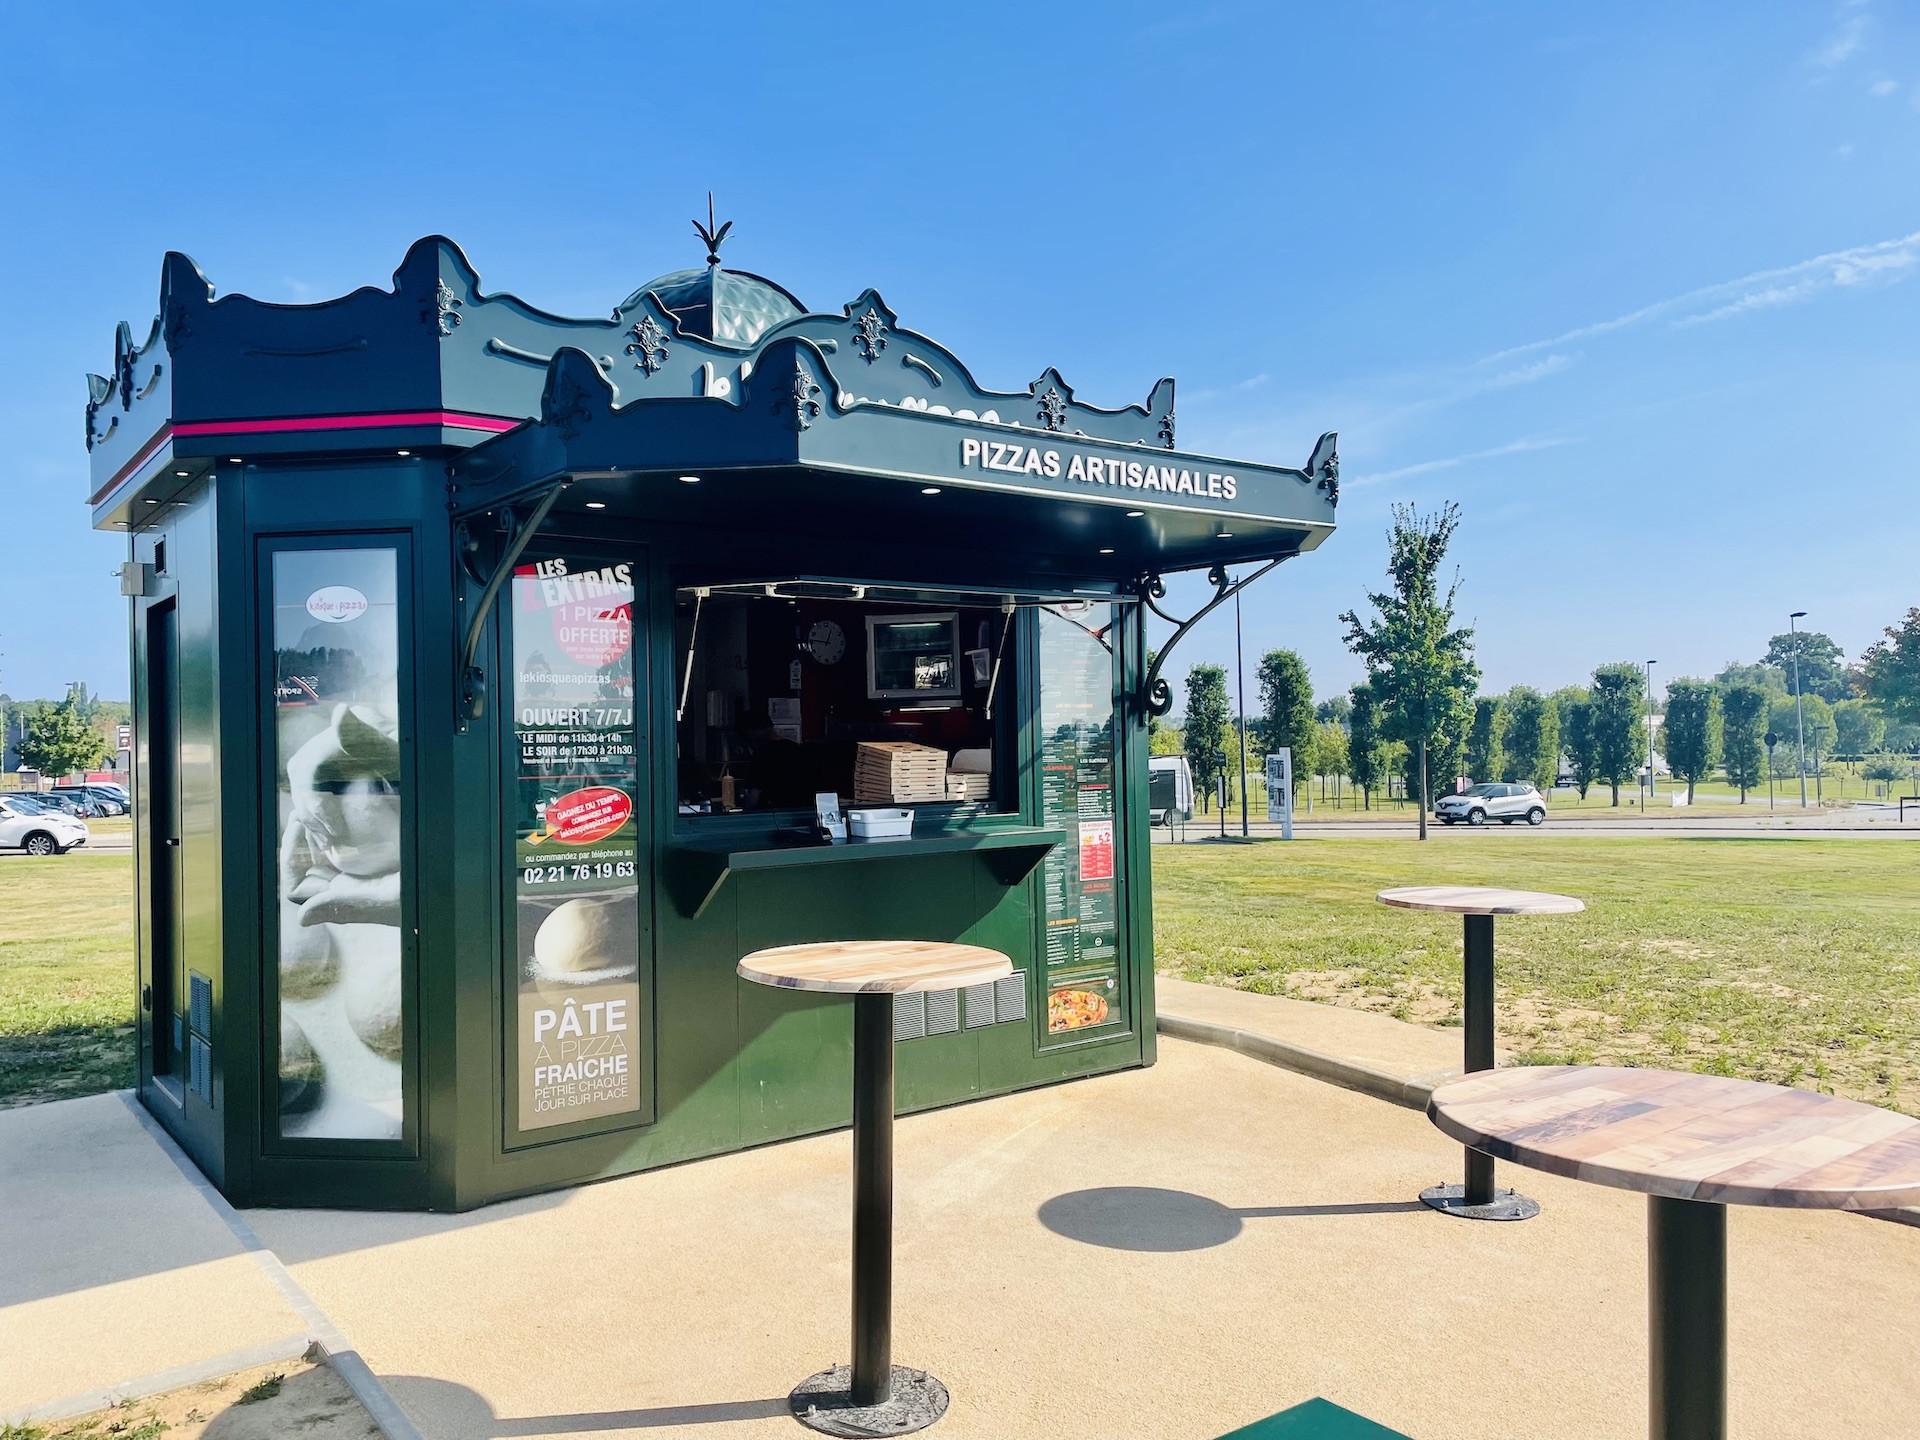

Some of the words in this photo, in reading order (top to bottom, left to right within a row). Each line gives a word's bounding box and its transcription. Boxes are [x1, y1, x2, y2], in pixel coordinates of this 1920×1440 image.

[962, 438, 1061, 478] PIZZAS
[1067, 455, 1238, 500] ARTISANALES
[536, 558, 567, 580] LES
[541, 564, 632, 608] EXTRAS
[560, 606, 567, 621] 1
[575, 606, 629, 624] PIZZA
[560, 627, 629, 645] OFFERTE
[519, 671, 611, 685] lekiosqueapizzas
[522, 708, 589, 726] OUVERT
[595, 708, 632, 726] 7/7J
[523, 734, 534, 744] LE
[536, 733, 557, 743] MIDI
[559, 733, 570, 743] de
[571, 733, 597, 743] 11h30
[600, 733, 606, 742] à
[606, 733, 622, 743] 14h
[523, 746, 534, 756] LE
[536, 746, 557, 756] SOIR
[560, 746, 571, 755] de
[572, 746, 598, 755] 17h30
[600, 746, 606, 755] à
[607, 745, 633, 755] 21h30
[557, 805, 585, 820] GAGNEZ
[585, 801, 596, 811] DU
[602, 806, 612, 815] SUR
[525, 855, 534, 863] ou
[536, 851, 577, 862] commandez
[579, 852, 591, 861] par
[591, 850, 623, 860] téléphone
[524, 867, 544, 885] 02
[548, 866, 565, 883] 21
[571, 865, 590, 880] 76
[594, 863, 612, 879] 19
[616, 861, 635, 877] 63
[534, 997, 627, 1043] PÂTE
[535, 1040, 552, 1065] À
[561, 1034, 627, 1061] PIZZA
[534, 1054, 628, 1087] FRAÎCHE
[535, 1083, 575, 1100] PÉTRIE
[579, 1075, 628, 1091] CHAQUE
[534, 1098, 565, 1113] JOUR
[568, 1094, 590, 1107] SUR
[594, 1087, 628, 1101] PLACE
